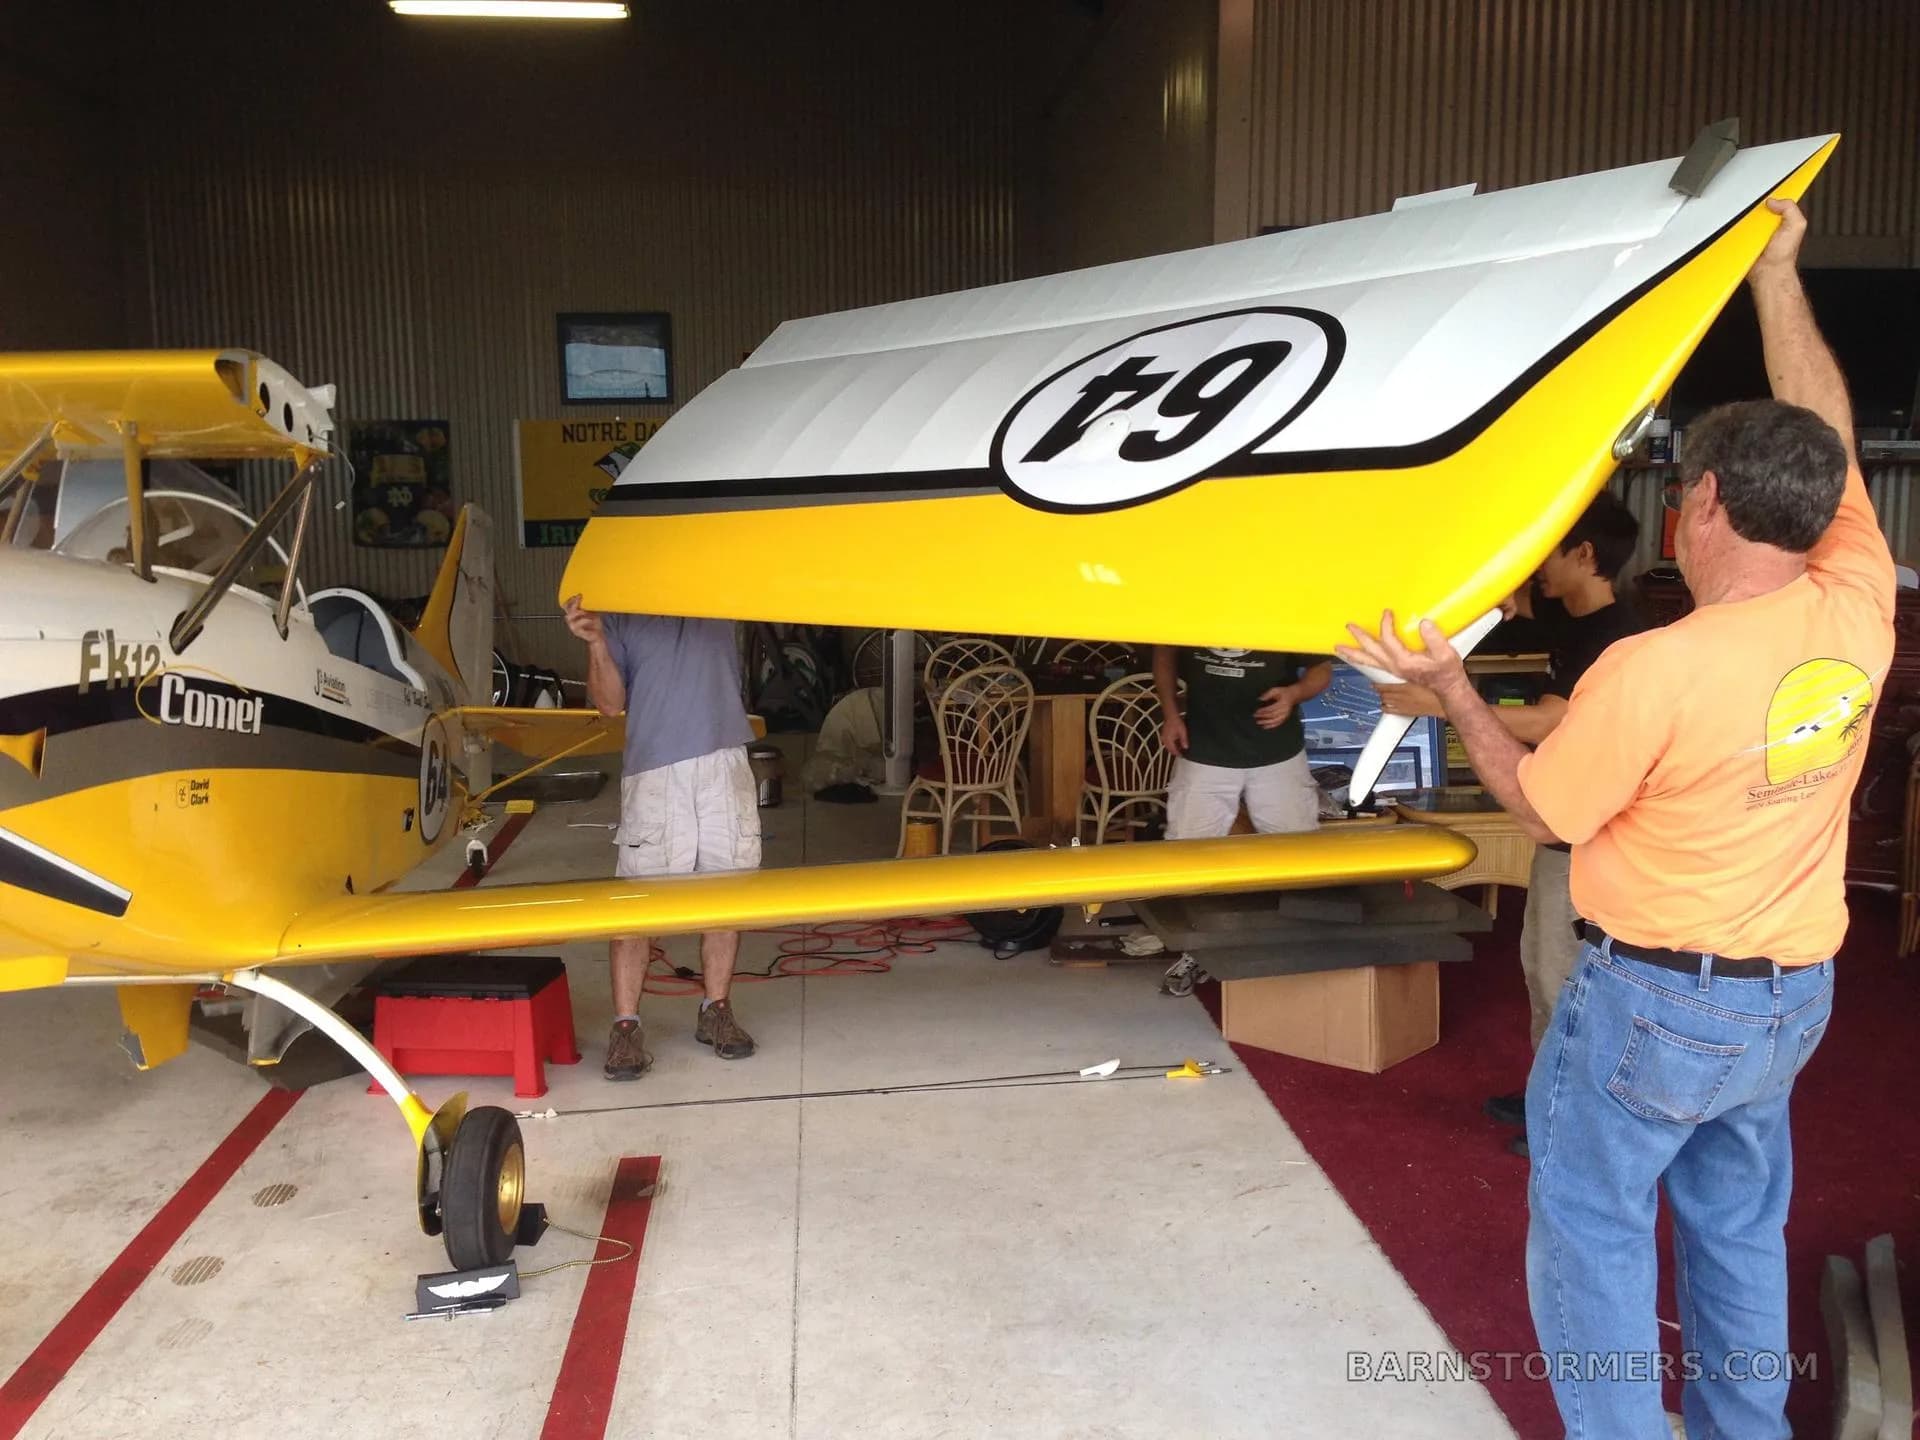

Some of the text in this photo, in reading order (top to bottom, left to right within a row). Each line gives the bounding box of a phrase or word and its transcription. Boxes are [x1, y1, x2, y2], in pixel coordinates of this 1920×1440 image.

[1019, 340, 1293, 463] 64
[562, 422, 661, 443] NOTRE DA
[160, 674, 264, 735] Comet
[191, 778, 210, 791] David
[191, 793, 209, 806] Clark
